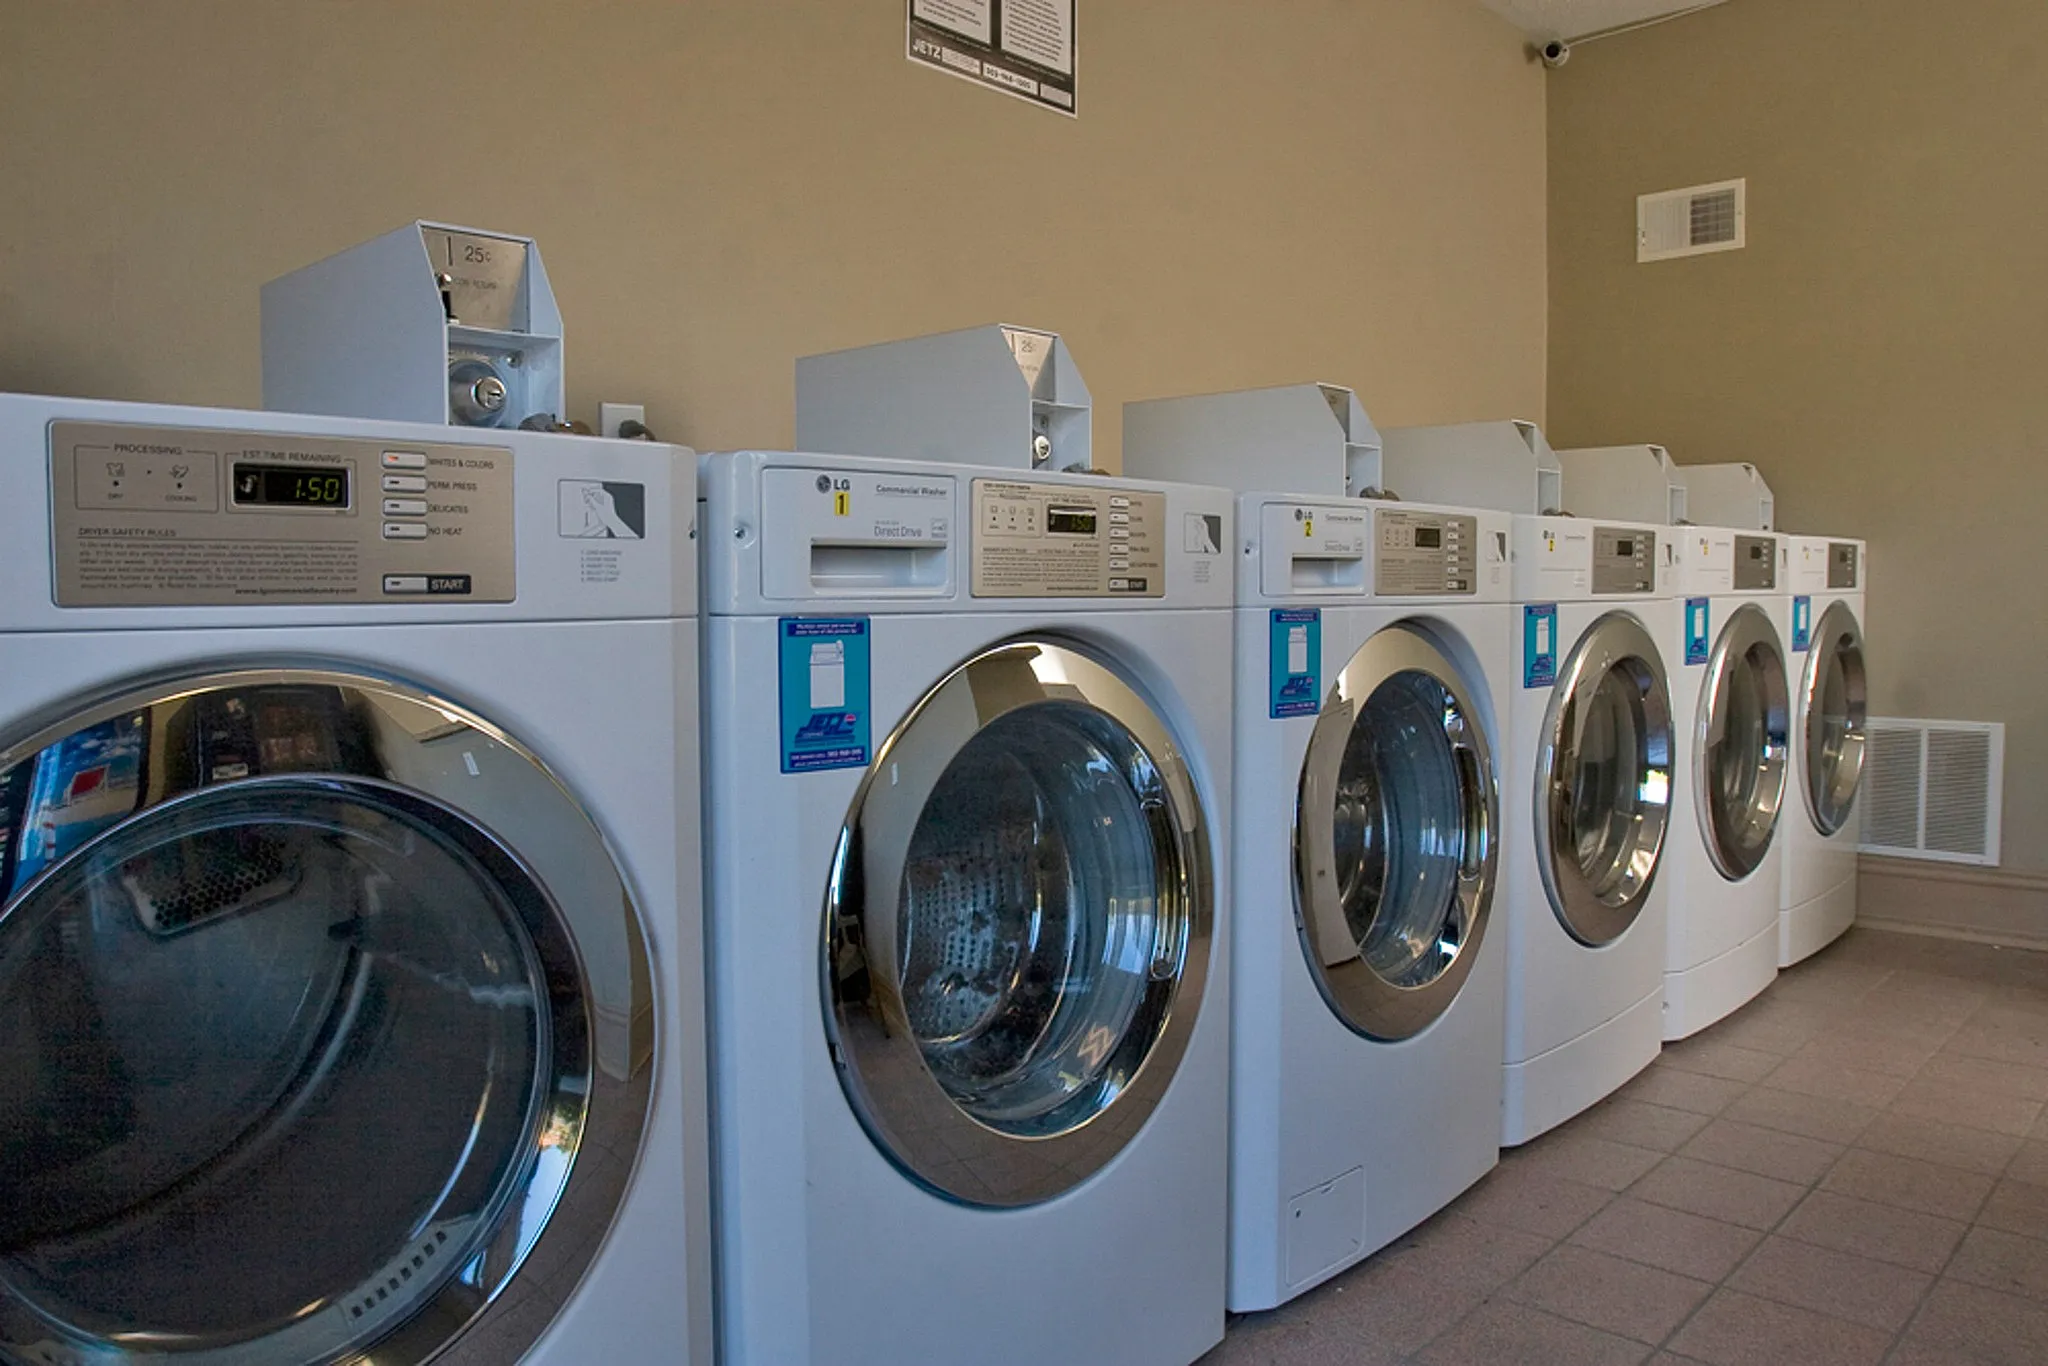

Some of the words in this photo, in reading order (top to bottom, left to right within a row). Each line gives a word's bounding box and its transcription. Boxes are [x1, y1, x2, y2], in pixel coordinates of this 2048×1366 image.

[464, 245, 492, 263] 25¢
[113, 443, 183, 455] PROCESSING
[264, 452, 286, 462] TIME
[288, 453, 341, 464] REMAINING
[428, 458, 457, 468] WHITES
[465, 460, 495, 470] COLORS
[452, 481, 478, 491] PRESS
[875, 484, 920, 495] Commercial
[921, 486, 947, 496] Washer
[428, 504, 469, 514] DELICATES
[838, 493, 845, 515] 1
[78, 527, 111, 536] DRYER
[112, 528, 145, 537] SAFETY
[428, 526, 441, 536] NO
[442, 527, 463, 536] HEAT
[874, 525, 900, 538] Direct
[901, 526, 922, 538] Drive
[431, 579, 465, 591] START
